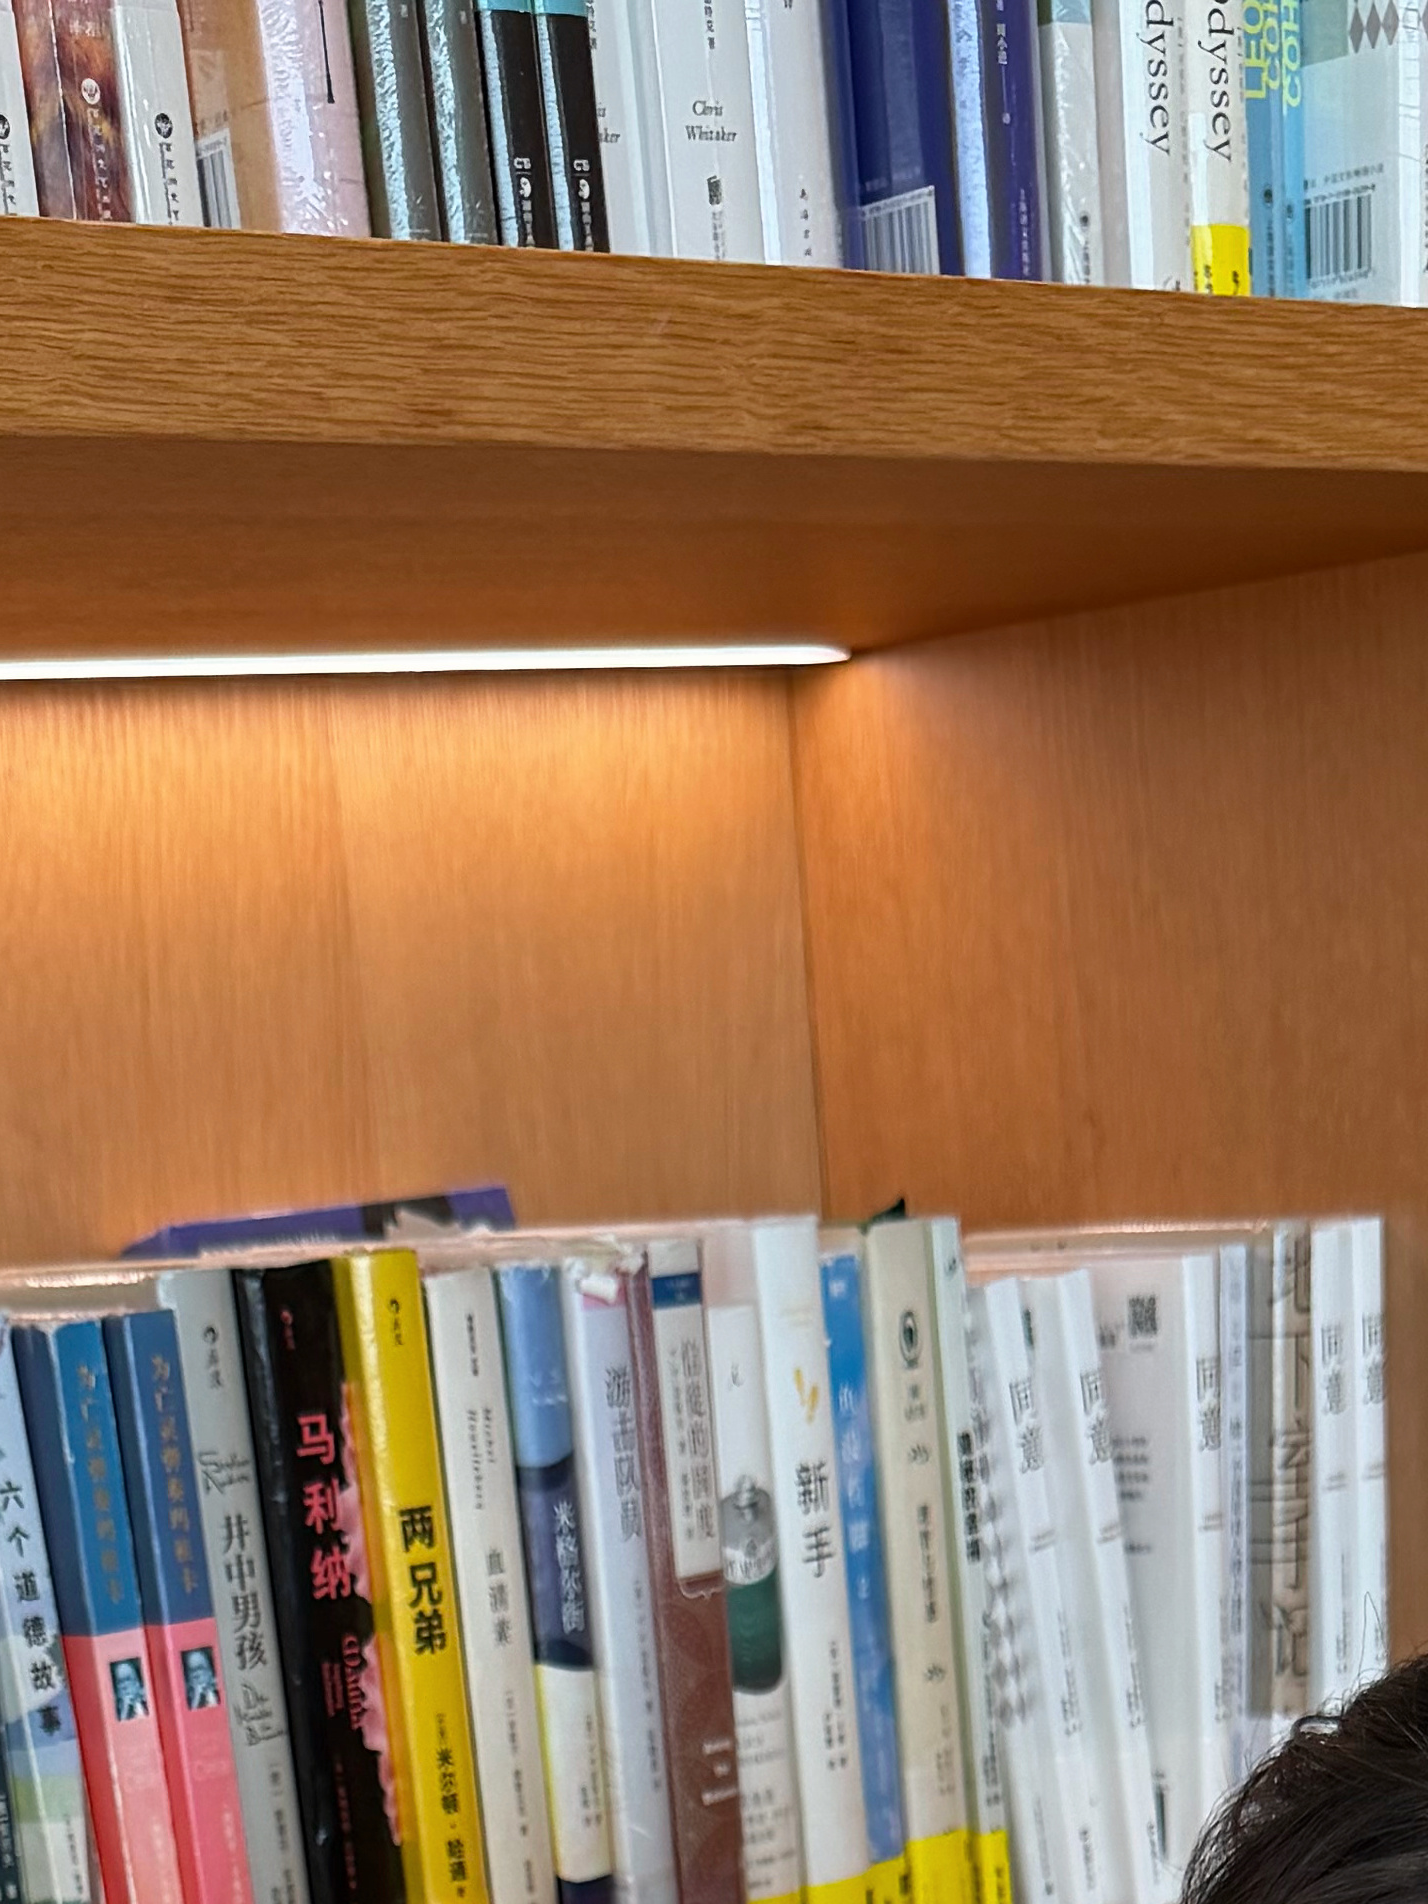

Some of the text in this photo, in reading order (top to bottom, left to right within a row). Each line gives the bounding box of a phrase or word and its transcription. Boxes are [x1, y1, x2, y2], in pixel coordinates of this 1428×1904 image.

[685, 125, 738, 143] Whitaker
[692, 100, 723, 117] Chris
[1136, 0, 1174, 157] dyssey
[1198, 0, 1235, 163] dyssey
[296, 1412, 355, 1602] 马利纳
[397, 1503, 449, 1660] 两兄弟
[792, 1459, 836, 1581] 新手
[218, 1511, 270, 1671] 井中男孩
